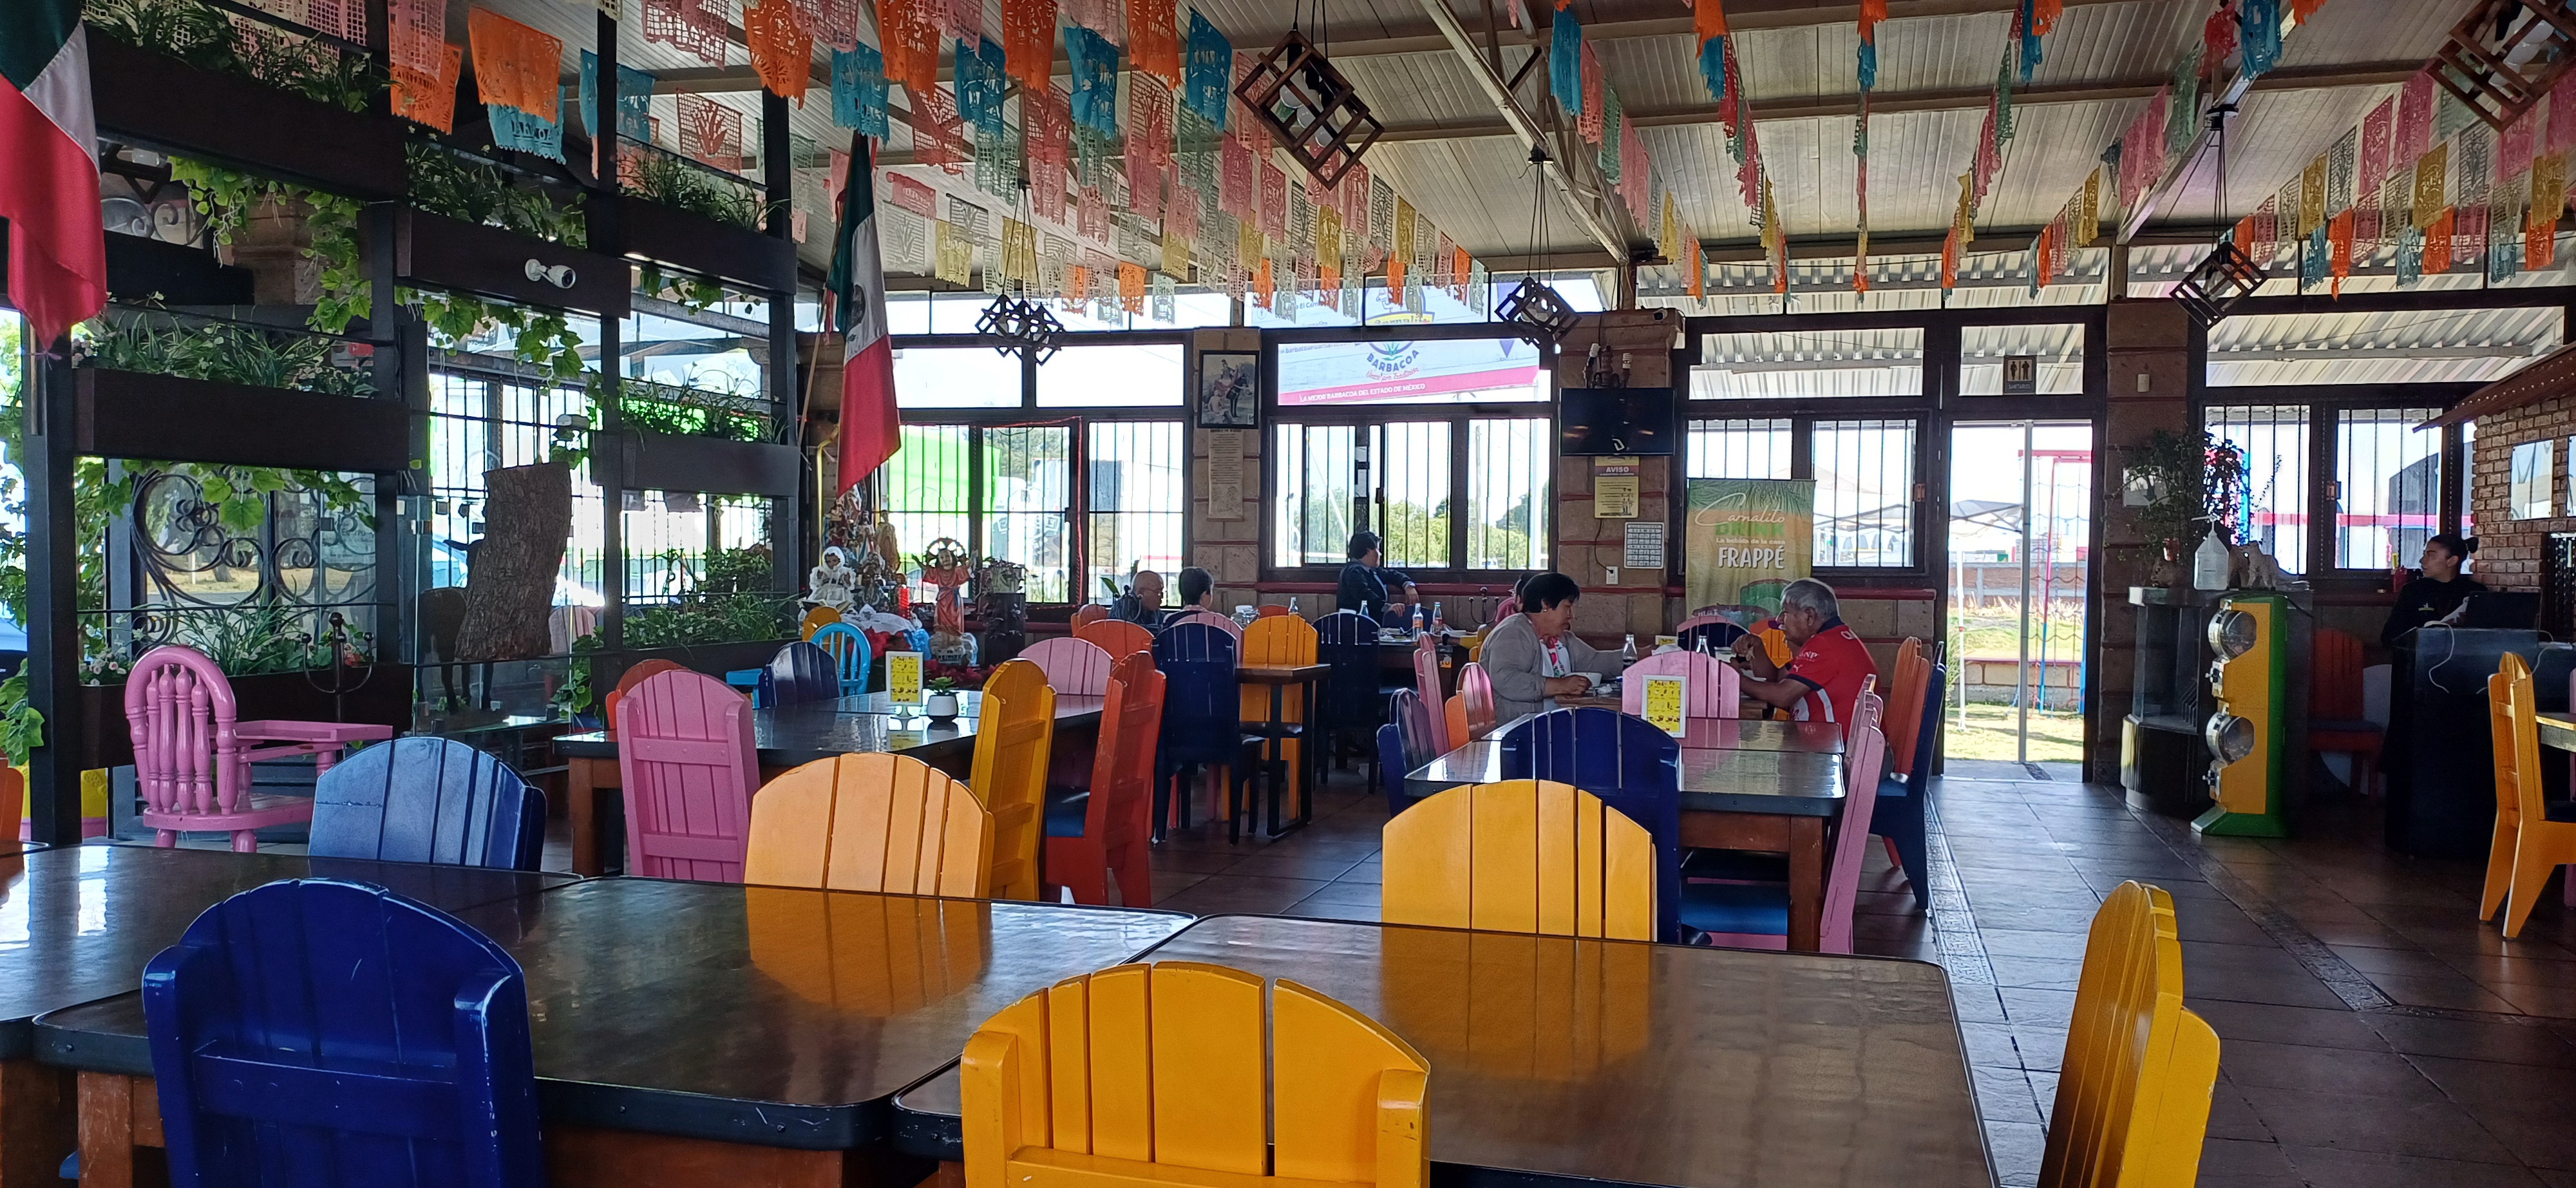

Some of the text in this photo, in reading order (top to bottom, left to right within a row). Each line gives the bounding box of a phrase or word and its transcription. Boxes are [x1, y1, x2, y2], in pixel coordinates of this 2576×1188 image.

[1367, 349, 1419, 372] BARBACOA
[1327, 390, 1358, 399] BARBACOA
[1403, 383, 1426, 391] MÉXICO
[1694, 492, 1785, 526] Carnalito
[1715, 522, 1785, 536] DRINK
[1718, 545, 1785, 570] FRAPPÉ
